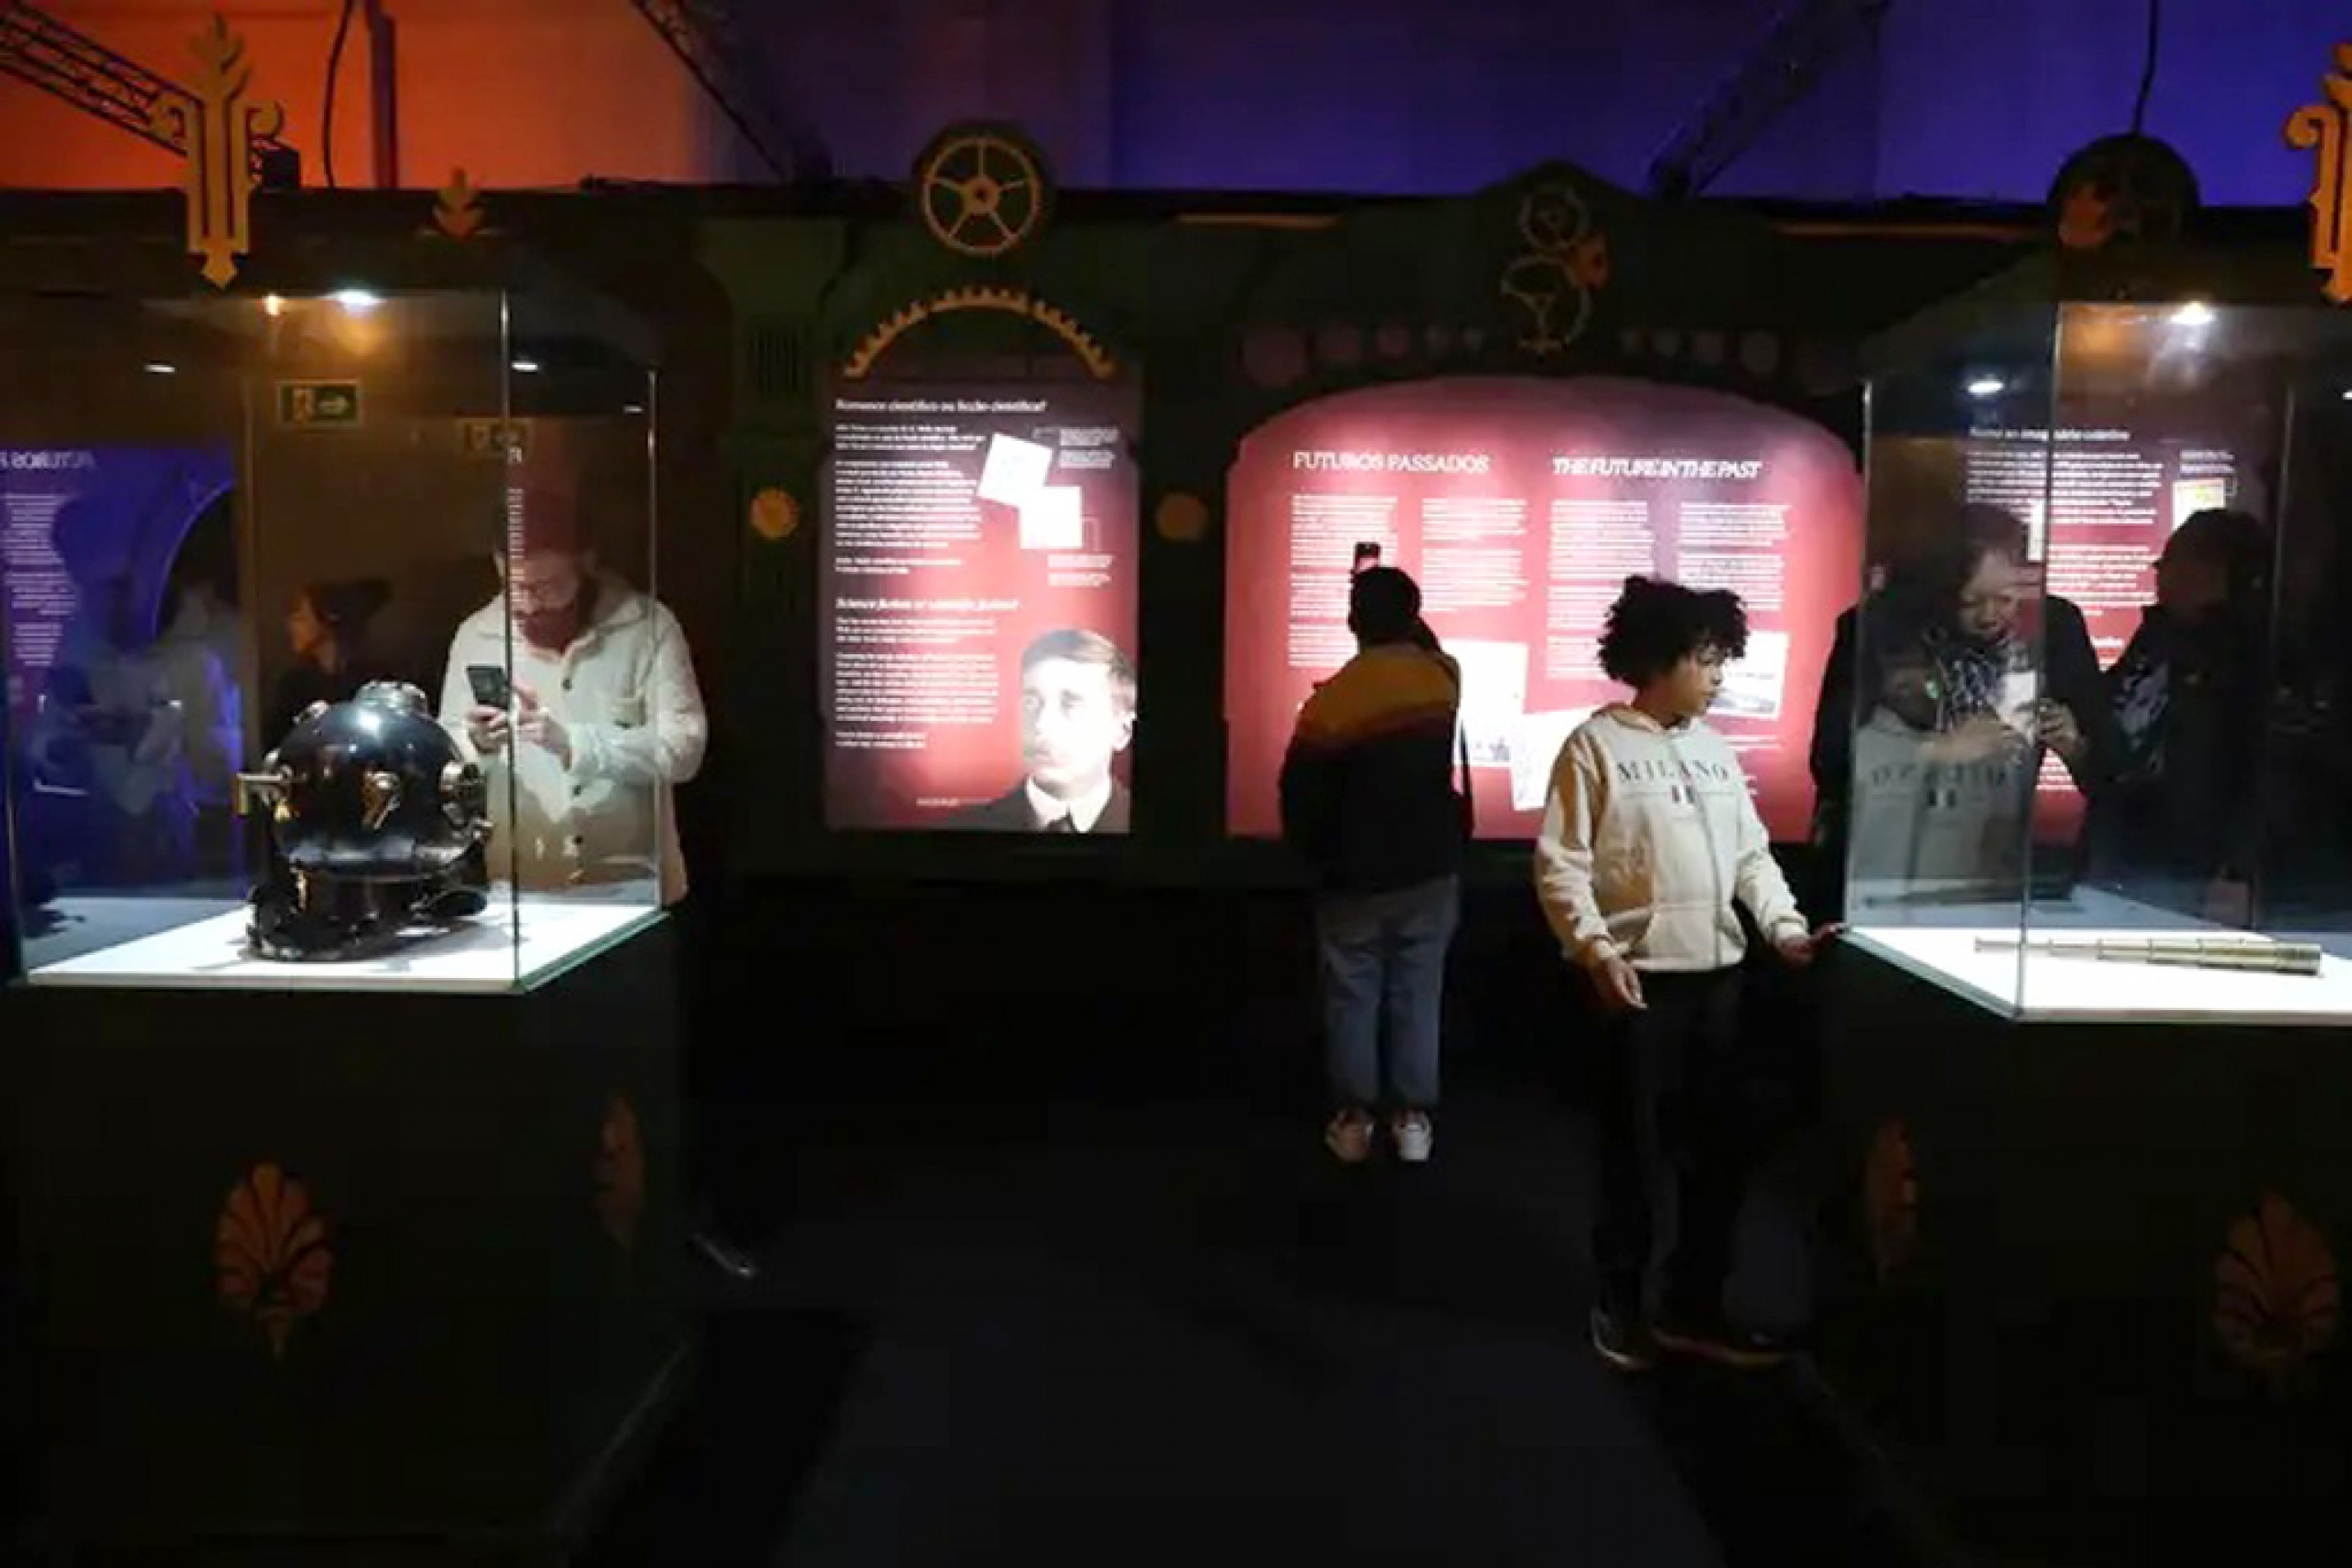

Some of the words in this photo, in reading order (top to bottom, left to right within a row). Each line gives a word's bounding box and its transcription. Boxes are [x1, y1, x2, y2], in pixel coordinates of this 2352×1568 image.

[1292, 451, 1383, 470] FUTUROS
[1388, 454, 1491, 474] PASSADOS
[1717, 461, 1762, 479] PAST
[1617, 759, 1730, 783] MILANO
